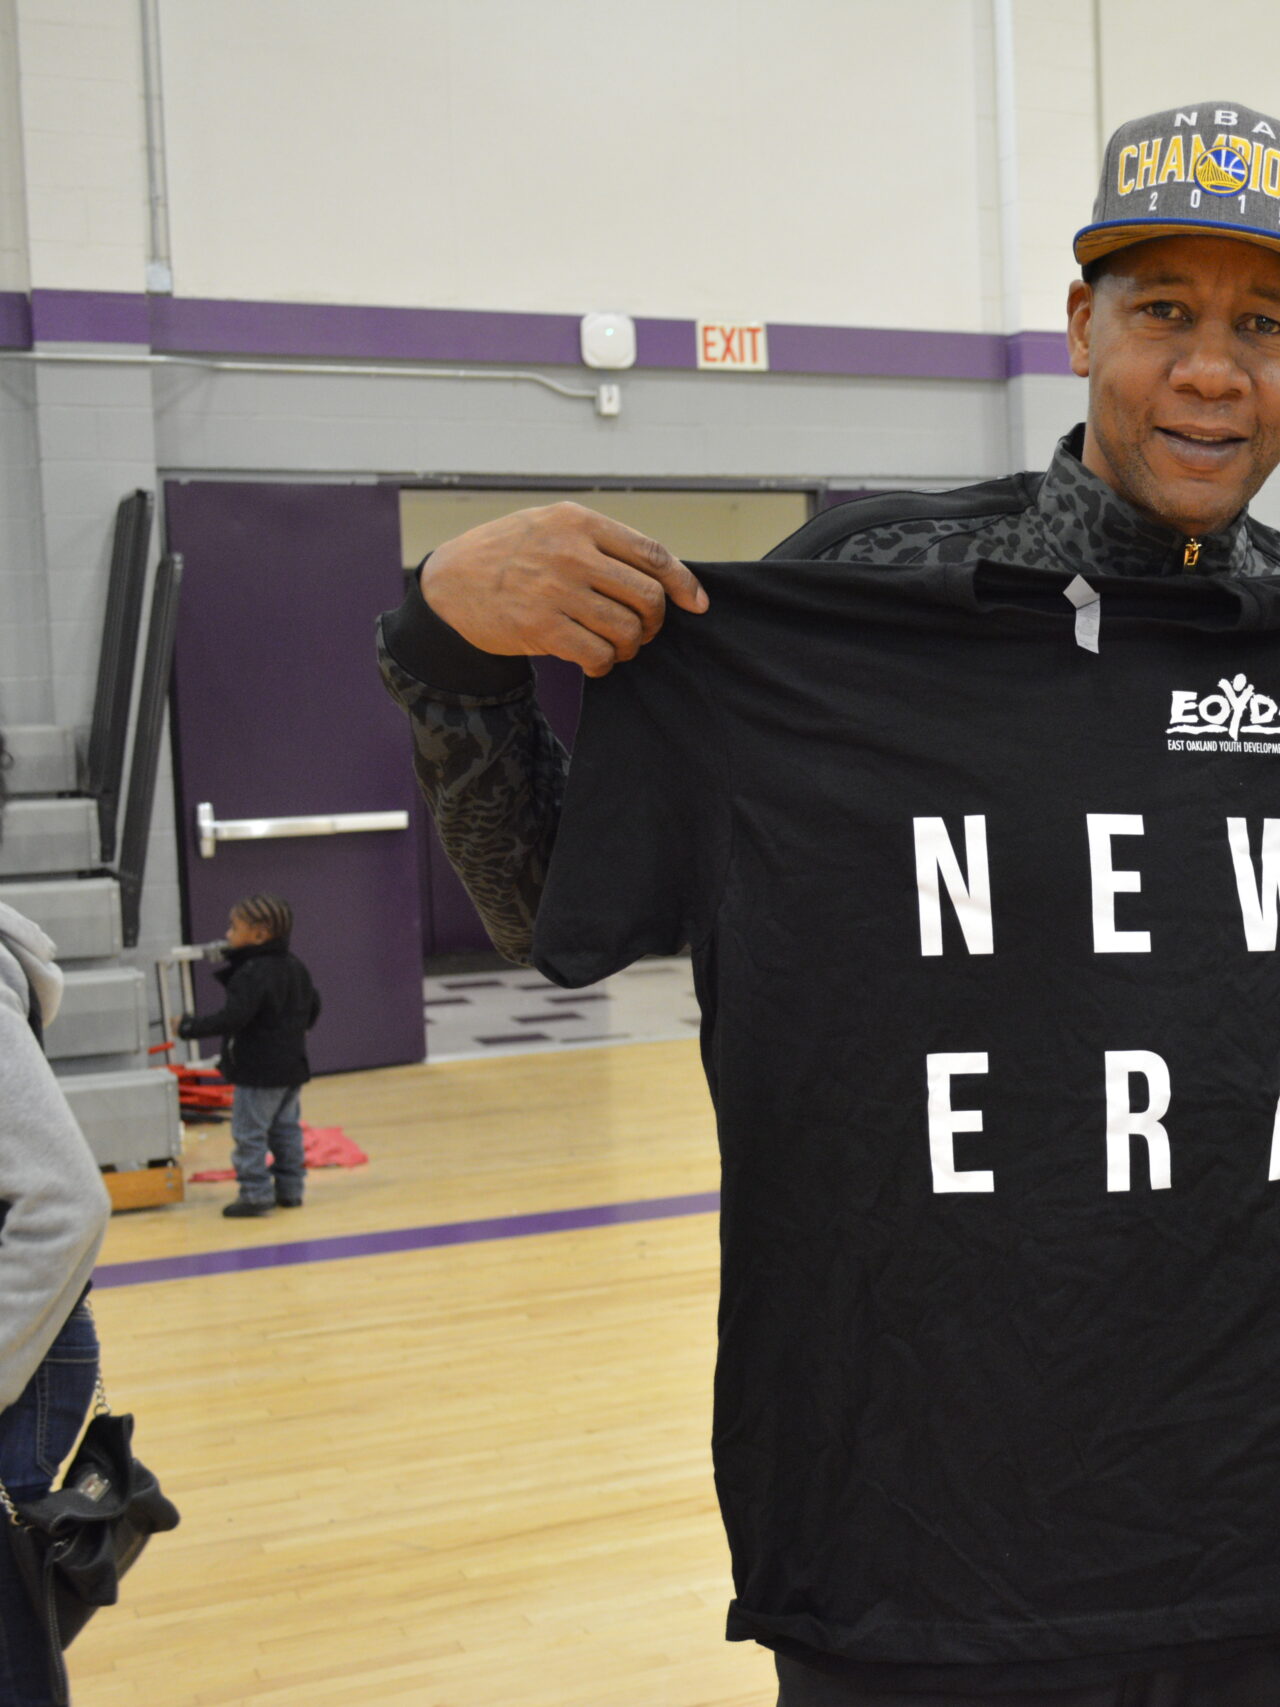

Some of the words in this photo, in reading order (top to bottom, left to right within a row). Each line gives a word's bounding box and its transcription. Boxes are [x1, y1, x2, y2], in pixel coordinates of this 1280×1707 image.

[1173, 110, 1276, 139] NBA
[703, 325, 761, 363] EXIT
[1167, 739, 1185, 751] EAST
[1186, 740, 1218, 752] OAKLAND
[1219, 741, 1242, 753] YOUTH
